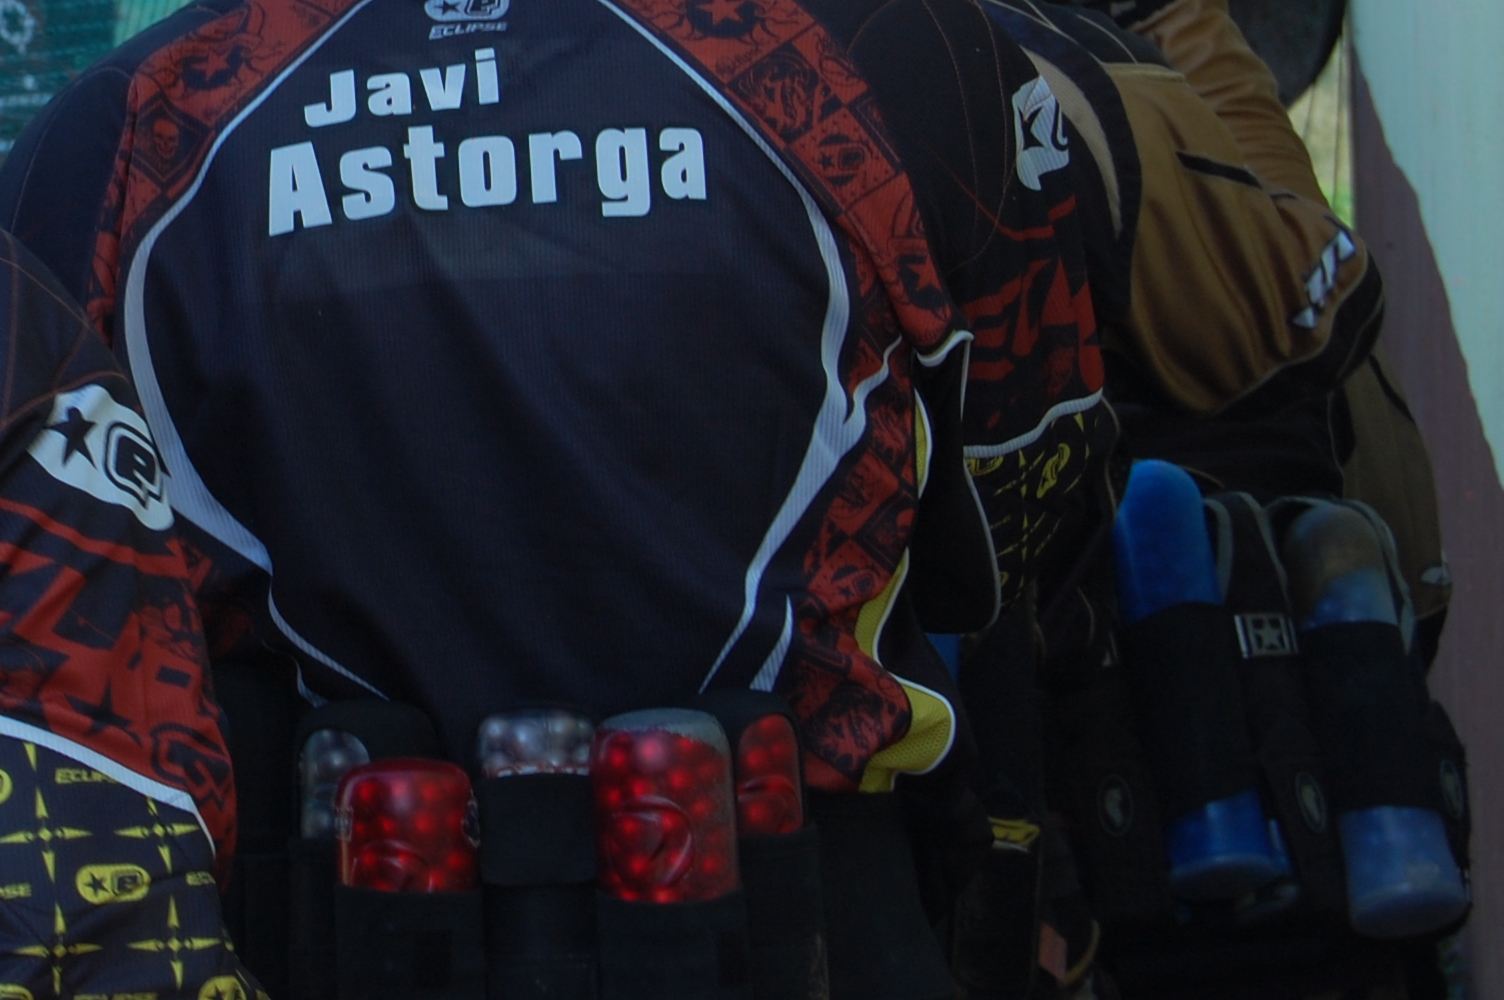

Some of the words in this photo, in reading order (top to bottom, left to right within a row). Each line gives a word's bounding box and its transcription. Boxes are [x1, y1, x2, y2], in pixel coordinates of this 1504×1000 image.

[428, 21, 508, 40] ECLIPSE
[304, 47, 500, 128] Javi
[268, 125, 707, 237] Astorga
